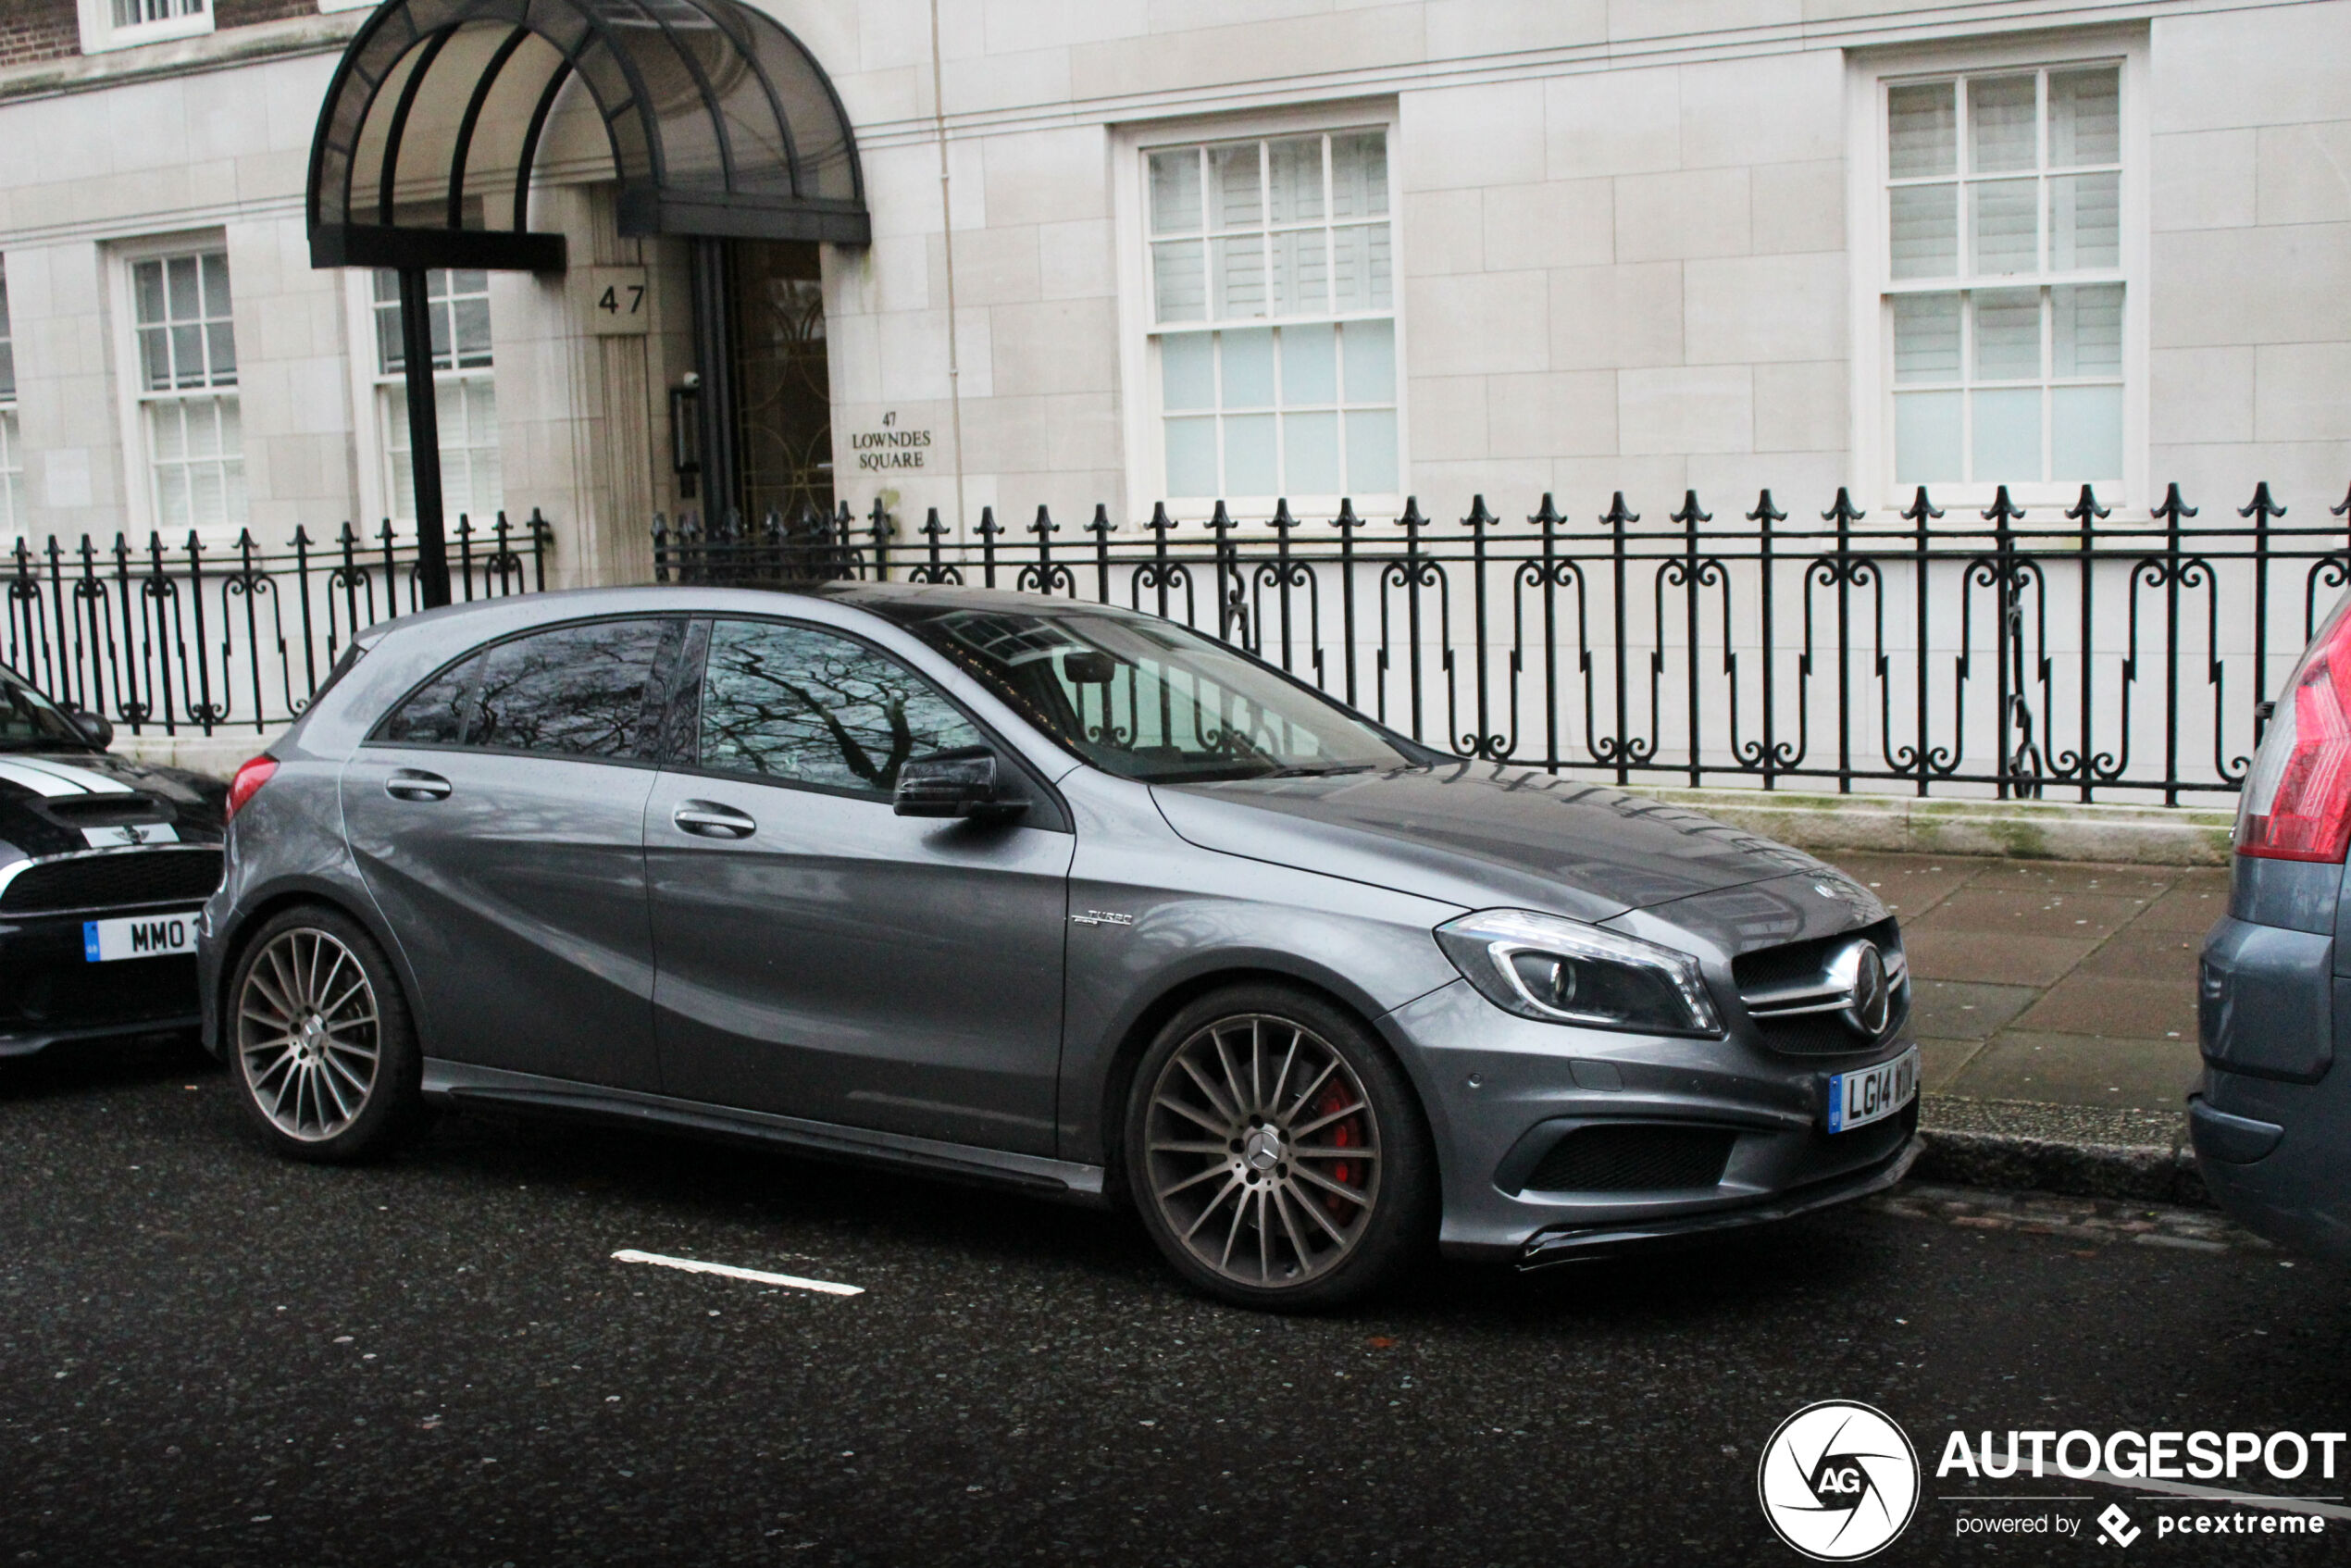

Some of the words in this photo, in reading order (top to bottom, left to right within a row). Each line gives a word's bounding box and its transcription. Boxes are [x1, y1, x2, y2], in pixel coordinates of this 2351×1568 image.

[598, 285, 645, 315] 47
[882, 411, 896, 427] 47
[852, 430, 931, 449] LOWNDES
[859, 452, 925, 473] SQUARE
